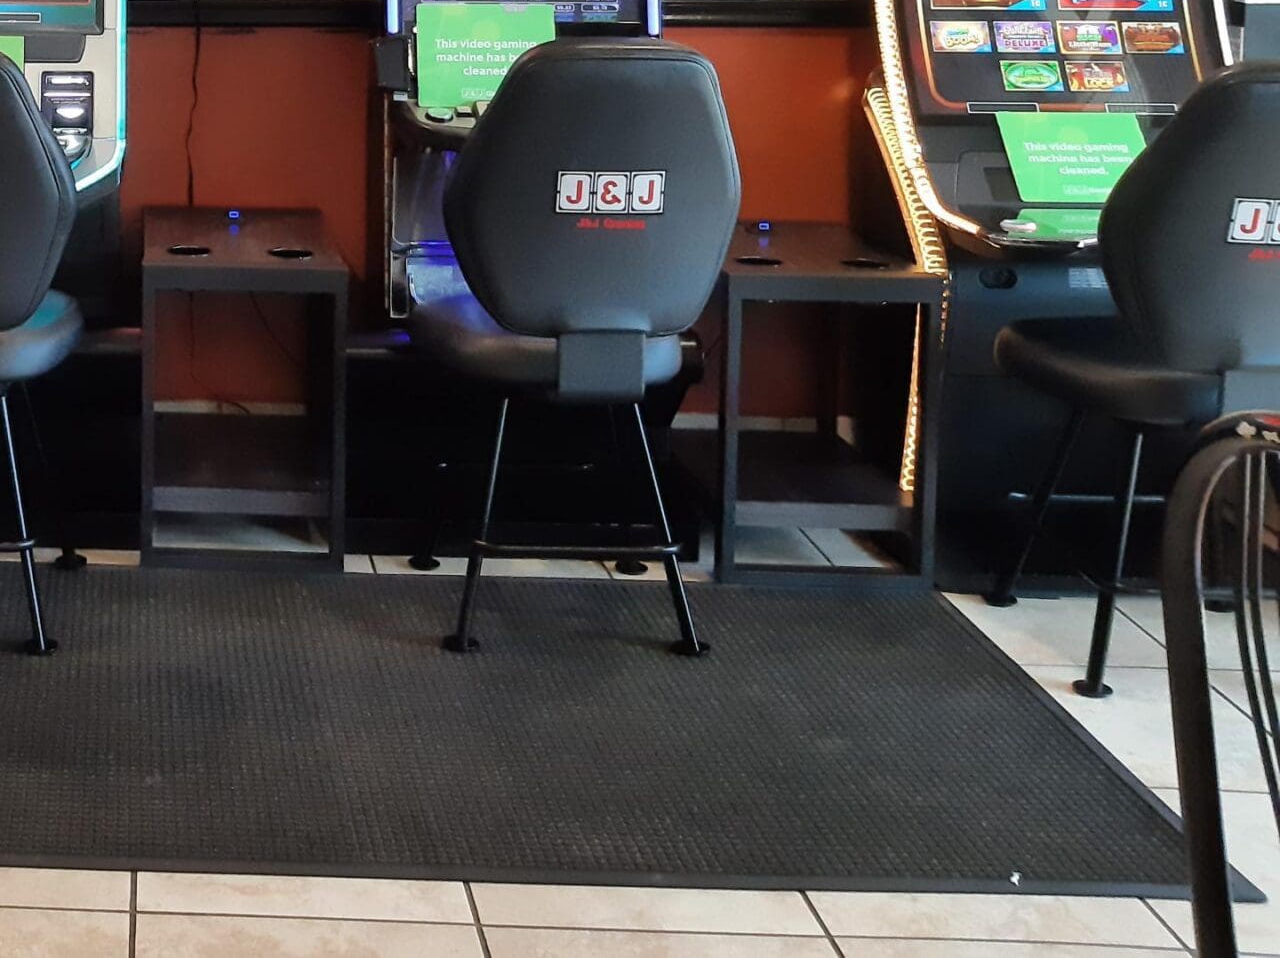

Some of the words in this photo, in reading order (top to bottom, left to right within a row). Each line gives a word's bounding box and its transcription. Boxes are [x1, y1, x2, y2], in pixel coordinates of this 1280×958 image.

[435, 39, 457, 49] This
[460, 39, 491, 49] video
[436, 52, 484, 62] machine
[486, 52, 506, 62] has
[1024, 142, 1047, 151] This
[1048, 142, 1082, 151] video
[1084, 143, 1129, 154] gaming
[1028, 154, 1077, 163] machine
[1079, 154, 1100, 163] has
[566, 179, 656, 205] J&J
